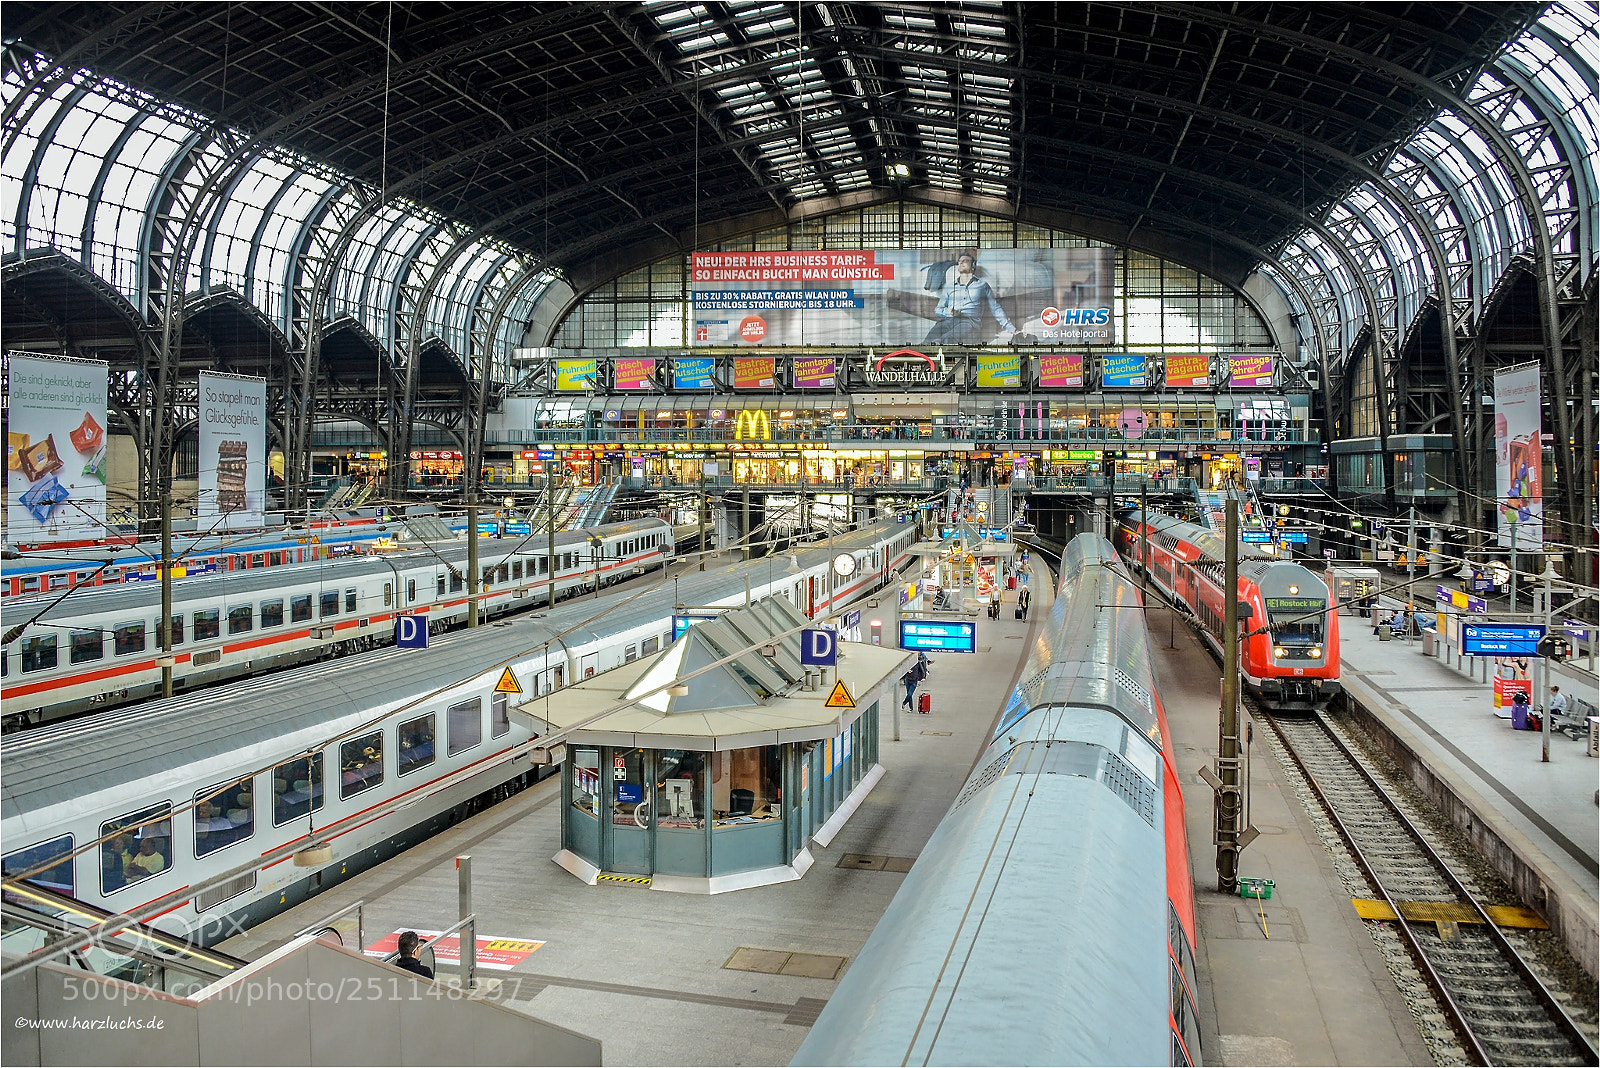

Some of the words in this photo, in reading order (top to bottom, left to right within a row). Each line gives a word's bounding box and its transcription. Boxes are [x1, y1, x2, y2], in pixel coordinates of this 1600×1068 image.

[696, 256, 722, 266] NEU!
[725, 256, 746, 266] DER
[749, 256, 771, 266] HRS
[774, 256, 828, 266] BUSINESS
[830, 255, 866, 265] TARIF:
[696, 269, 710, 280] SO
[713, 269, 760, 280] EINFACH
[762, 268, 800, 280] BUCHT
[802, 268, 828, 279] MAN
[831, 266, 883, 279] GÜNSTIG.
[696, 292, 709, 300] BIS
[710, 292, 721, 300] ZU
[723, 292, 739, 300] 30%
[741, 292, 774, 301] RABATT,
[775, 291, 803, 300] GRATIS
[805, 291, 829, 300] WLAN
[830, 291, 848, 299] UND
[696, 301, 748, 309] KOSTENLOSE
[749, 301, 807, 309] STORNIERUNG
[1064, 309, 1110, 325] HRS
[1060, 330, 1108, 338] Hotelportal
[616, 360, 643, 370] Frisch
[675, 360, 704, 370] Dauer-
[735, 358, 768, 370] Esstra-
[794, 358, 835, 370] Sonntags-
[978, 358, 1020, 371] Frühreif?
[1040, 357, 1068, 367] Frisch
[1103, 357, 1134, 366] Dauer-
[1166, 357, 1202, 367] Esstra-
[1229, 356, 1272, 367] Sonntags-
[616, 365, 655, 378] verliebt?
[675, 365, 714, 378] lutscher?
[736, 364, 774, 376] vagant?
[795, 366, 825, 376] fahrer?
[1041, 362, 1082, 375] verliebt?
[1103, 362, 1145, 374] lutscher?
[1167, 362, 1208, 374] vagant?
[14, 372, 26, 383] Die
[28, 374, 42, 385] sind
[44, 376, 74, 388] geknickt,
[75, 377, 91, 388] aber
[866, 371, 947, 382] WANDELHALLE
[14, 387, 27, 398] alle
[29, 389, 59, 401] anderen
[60, 393, 74, 402] sind
[76, 392, 104, 406] glücklich.
[206, 387, 217, 402] So
[219, 389, 243, 408] stapelt
[245, 395, 260, 406] man
[206, 408, 259, 428] Glücksgefühle.
[1267, 599, 1278, 607] RE1
[401, 617, 416, 640] D
[1466, 628, 1477, 636] 6a
[812, 631, 832, 657] D
